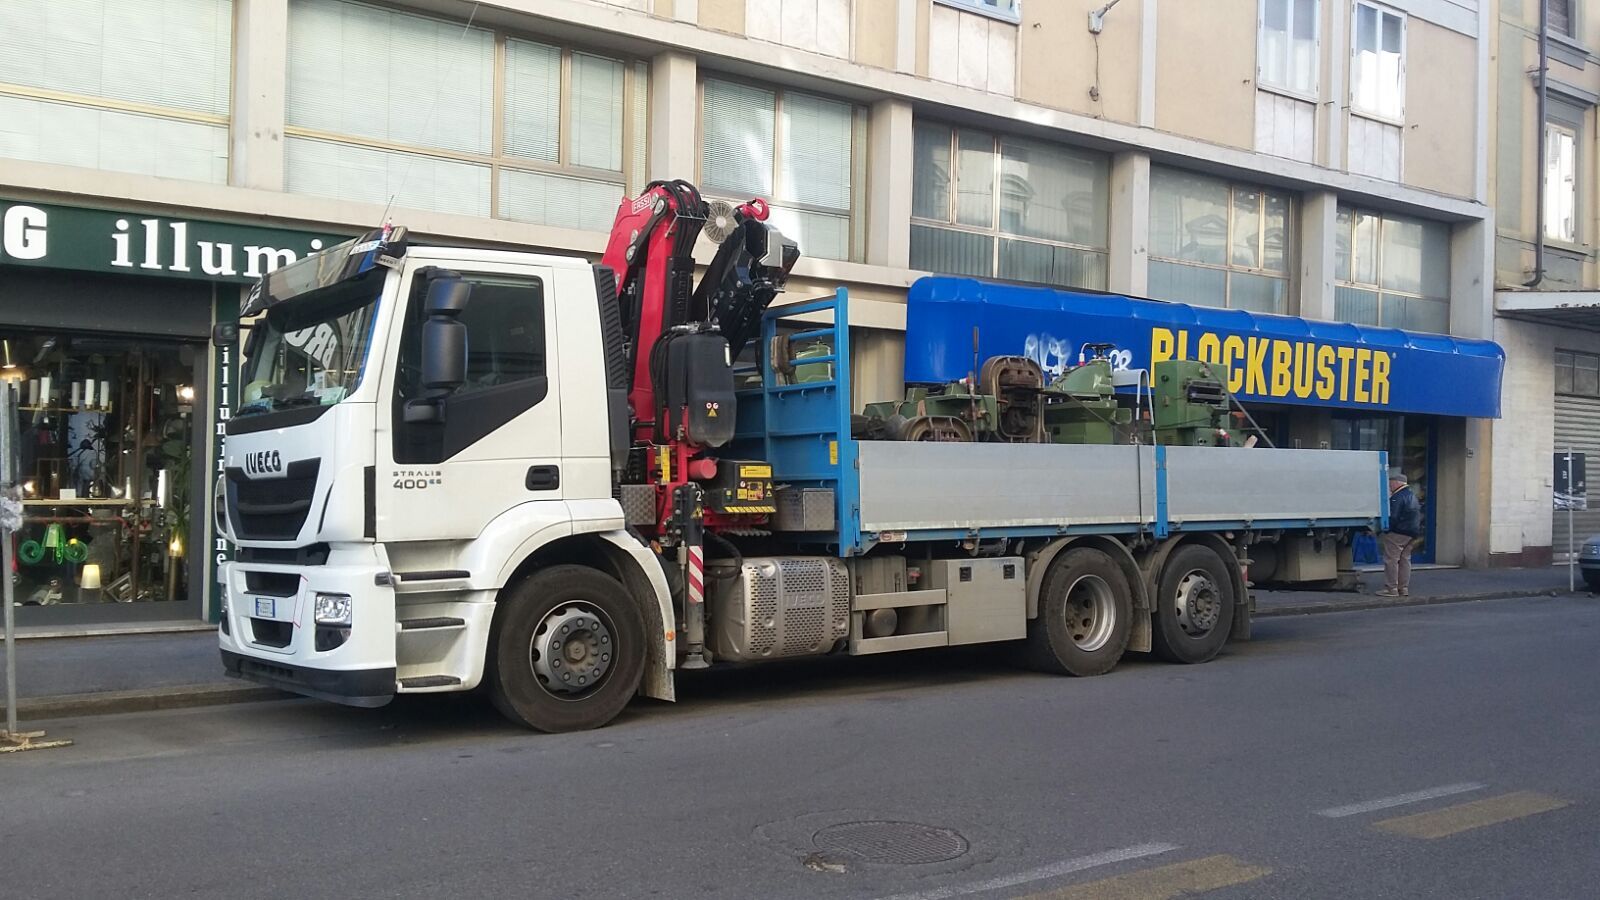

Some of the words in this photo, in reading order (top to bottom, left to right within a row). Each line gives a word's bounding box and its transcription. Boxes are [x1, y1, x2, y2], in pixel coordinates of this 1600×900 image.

[633, 197, 650, 211] FASSI
[246, 450, 282, 475] IVECO
[393, 479, 427, 490] 400
